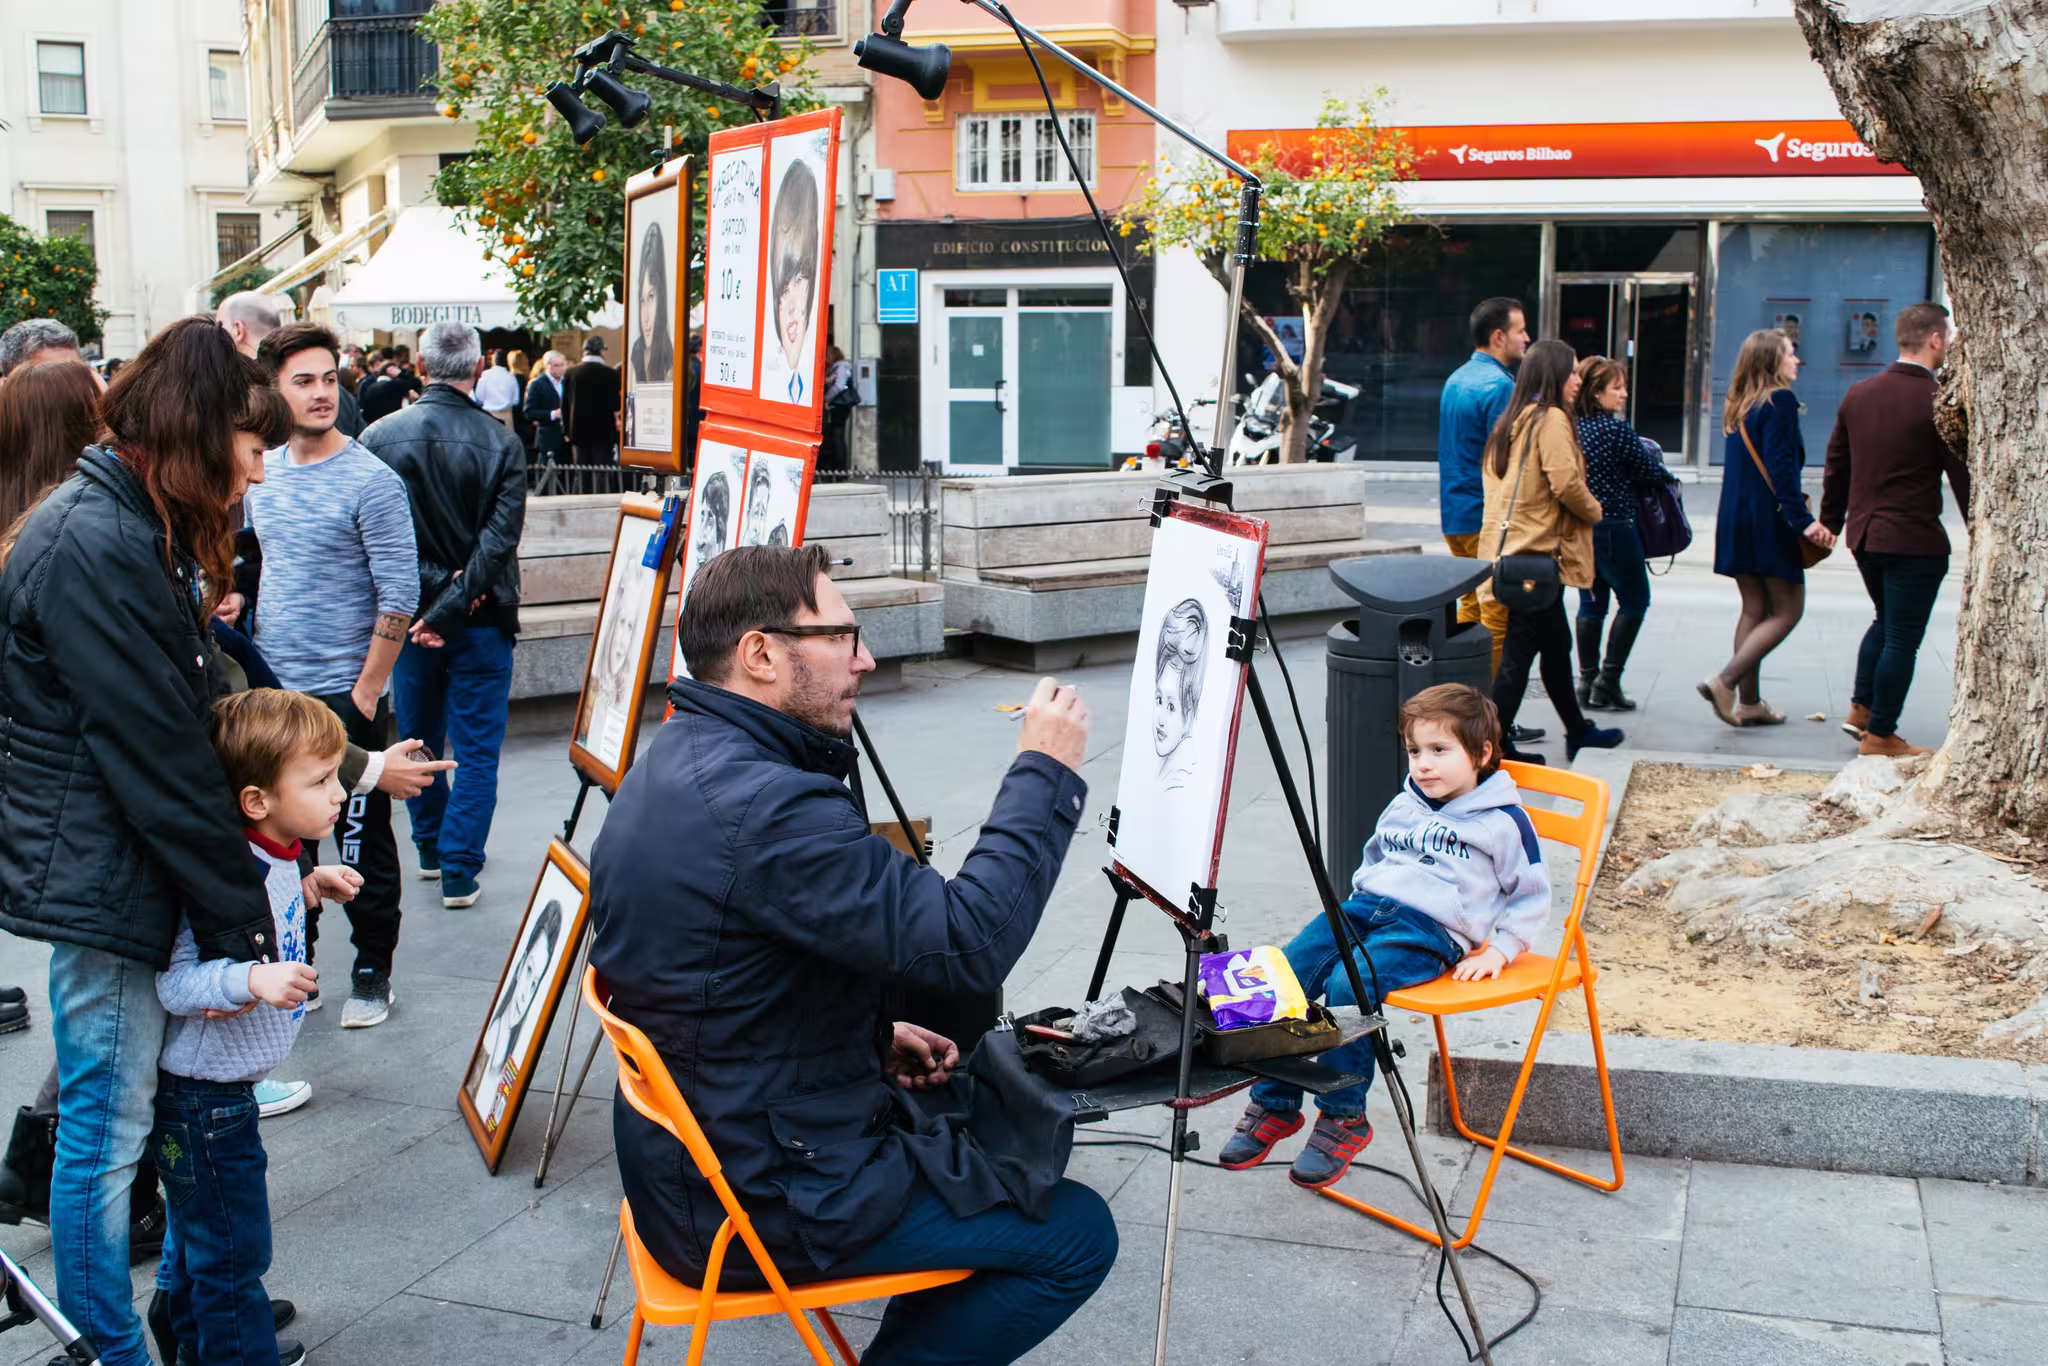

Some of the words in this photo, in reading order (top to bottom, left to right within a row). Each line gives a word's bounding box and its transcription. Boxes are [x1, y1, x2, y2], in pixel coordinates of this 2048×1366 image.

[1468, 147, 1525, 164] Seguros
[1526, 146, 1573, 161] Bilbao
[712, 159, 760, 208] CARICATURA
[722, 217, 748, 237] CARTOON
[933, 241, 994, 255] EDIFICIO
[721, 267, 733, 300] 10
[886, 273, 910, 291] AT
[391, 304, 483, 325] BODEGUITA
[341, 792, 367, 865] GIVO
[1420, 820, 1470, 860] YORK
